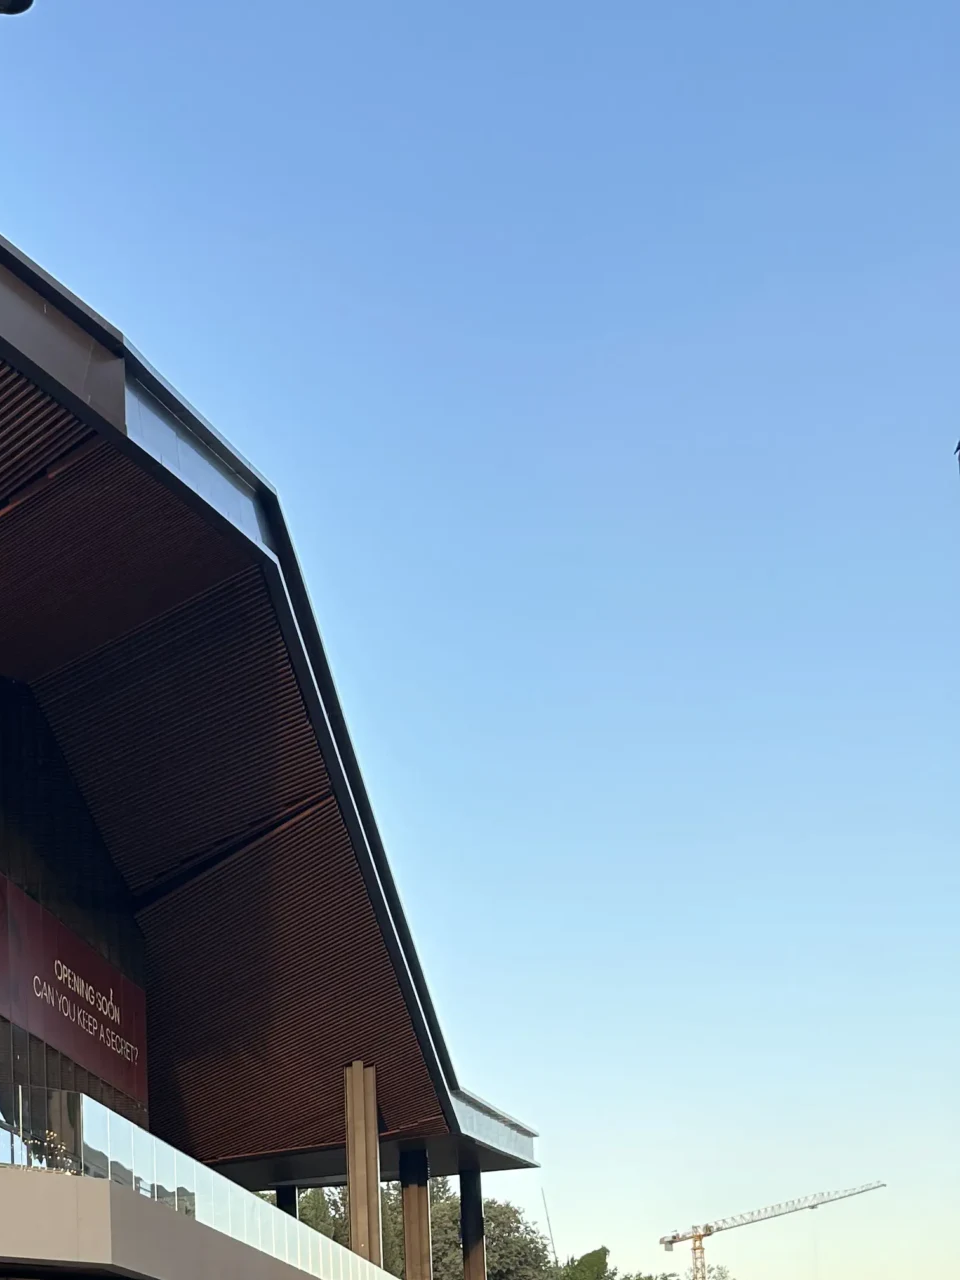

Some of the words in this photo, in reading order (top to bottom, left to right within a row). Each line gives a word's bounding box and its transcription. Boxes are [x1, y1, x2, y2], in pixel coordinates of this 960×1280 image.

[33, 975, 55, 1007] CAN
[55, 989, 76, 1022] YOU
[77, 1005, 98, 1036] KEEP
[99, 1023, 106, 1045] A
[105, 1027, 139, 1065] SECRET?
[54, 960, 96, 1006] OPENING
[95, 989, 120, 1025] SOON
